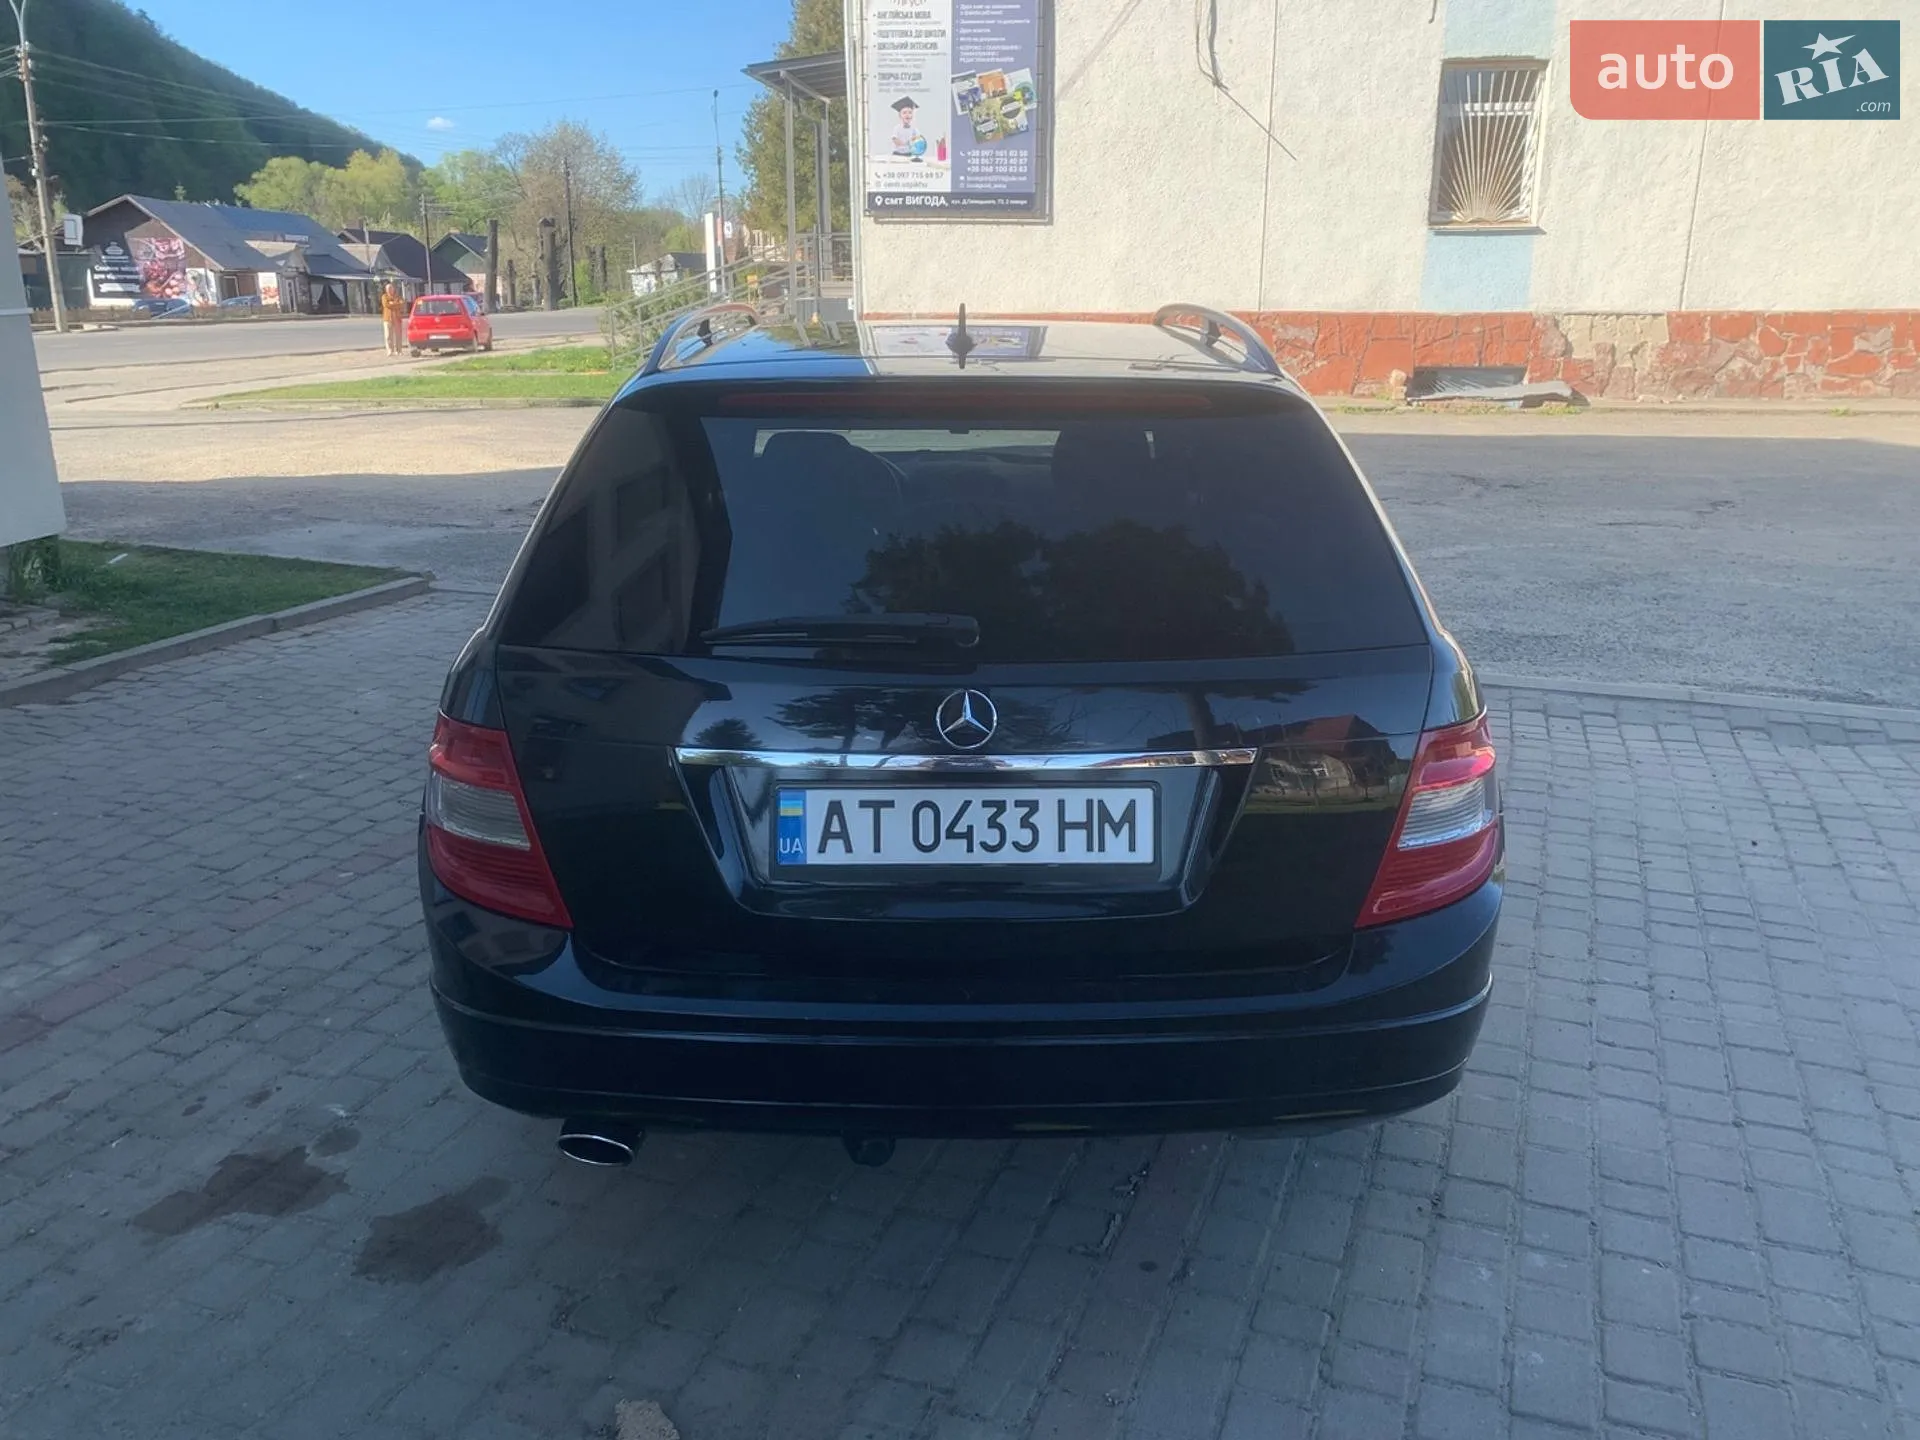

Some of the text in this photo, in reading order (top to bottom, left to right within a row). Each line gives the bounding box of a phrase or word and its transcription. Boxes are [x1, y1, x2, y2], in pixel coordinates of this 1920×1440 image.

[905, 195, 949, 207] ВИГОДА,
[817, 799, 1136, 854] AT 0433 HM
[779, 838, 804, 854] UA
